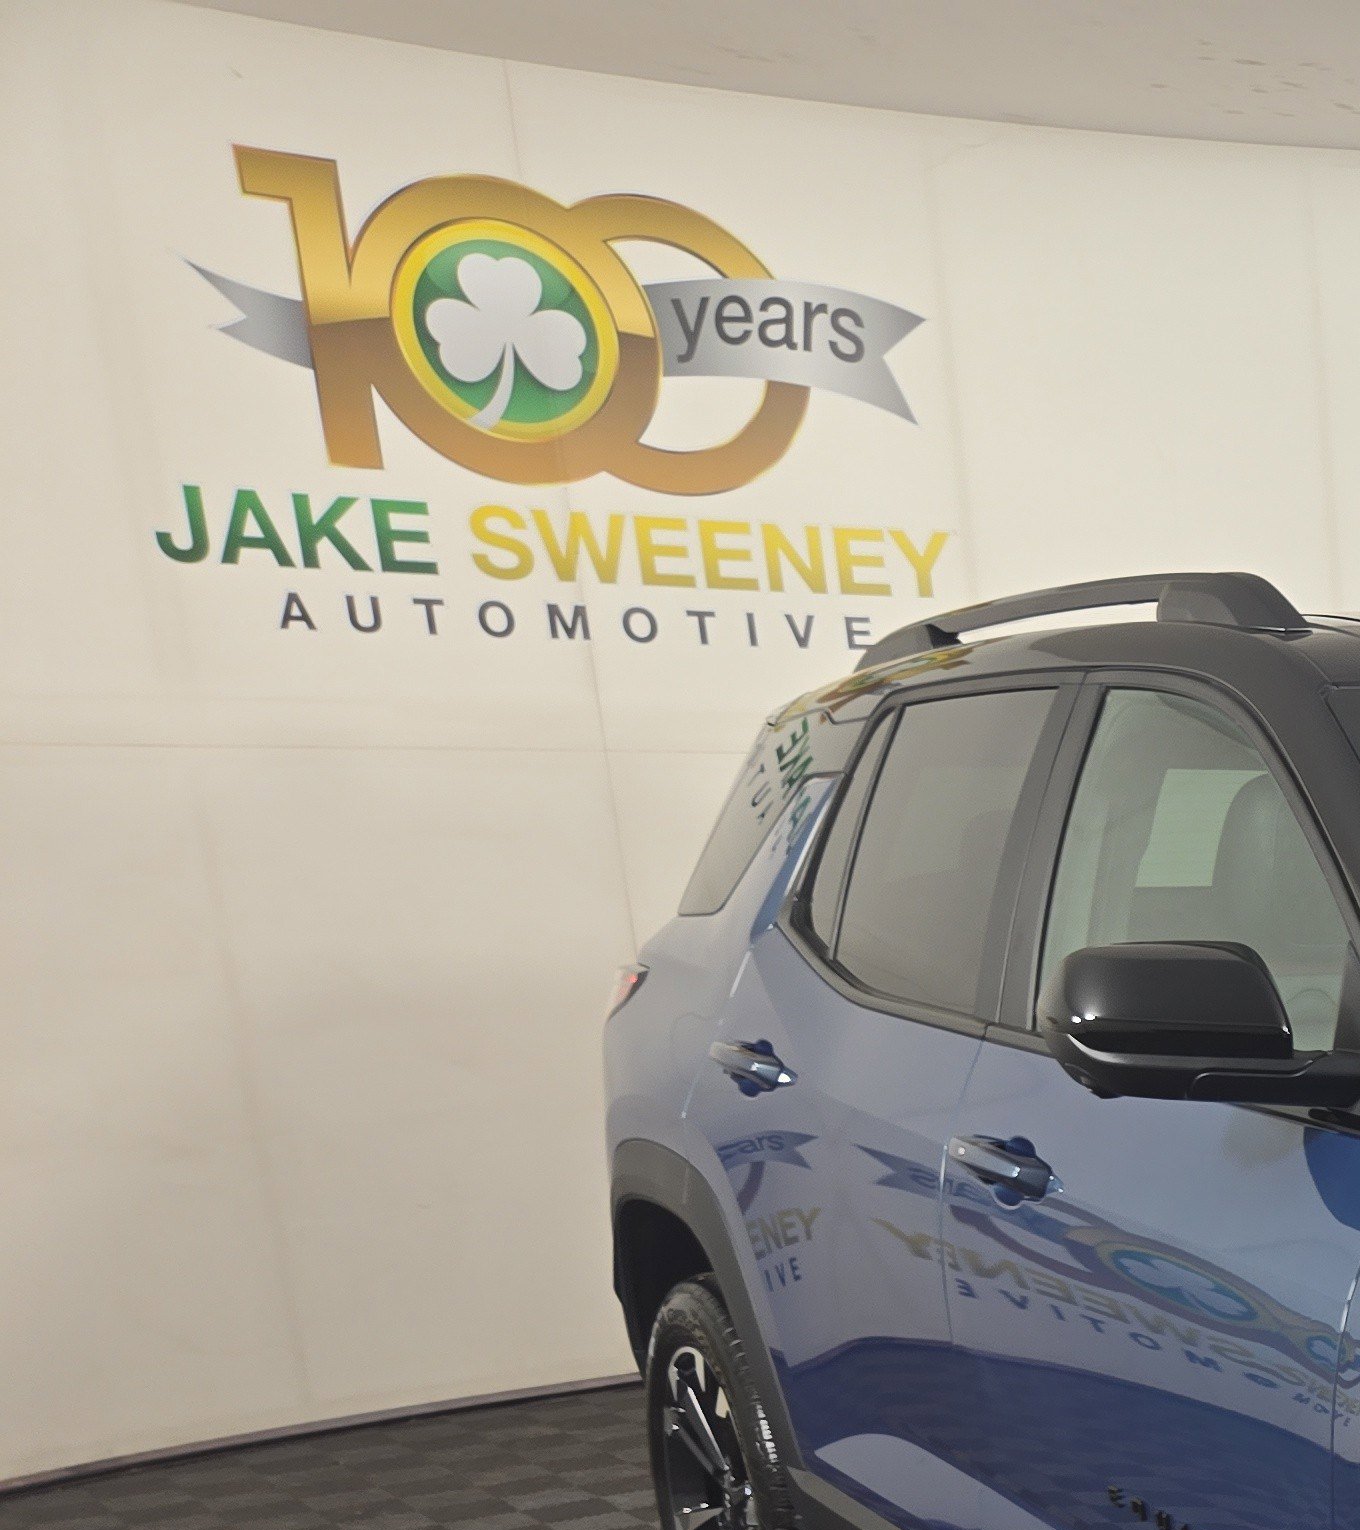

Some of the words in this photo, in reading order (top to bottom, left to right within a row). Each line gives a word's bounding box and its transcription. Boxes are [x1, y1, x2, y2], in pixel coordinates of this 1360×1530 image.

[231, 143, 811, 496] 100
[672, 294, 867, 364] years
[155, 483, 438, 576] JAKE
[469, 504, 951, 598] SWEENEY
[280, 592, 873, 652] AUTOMOTIVE
